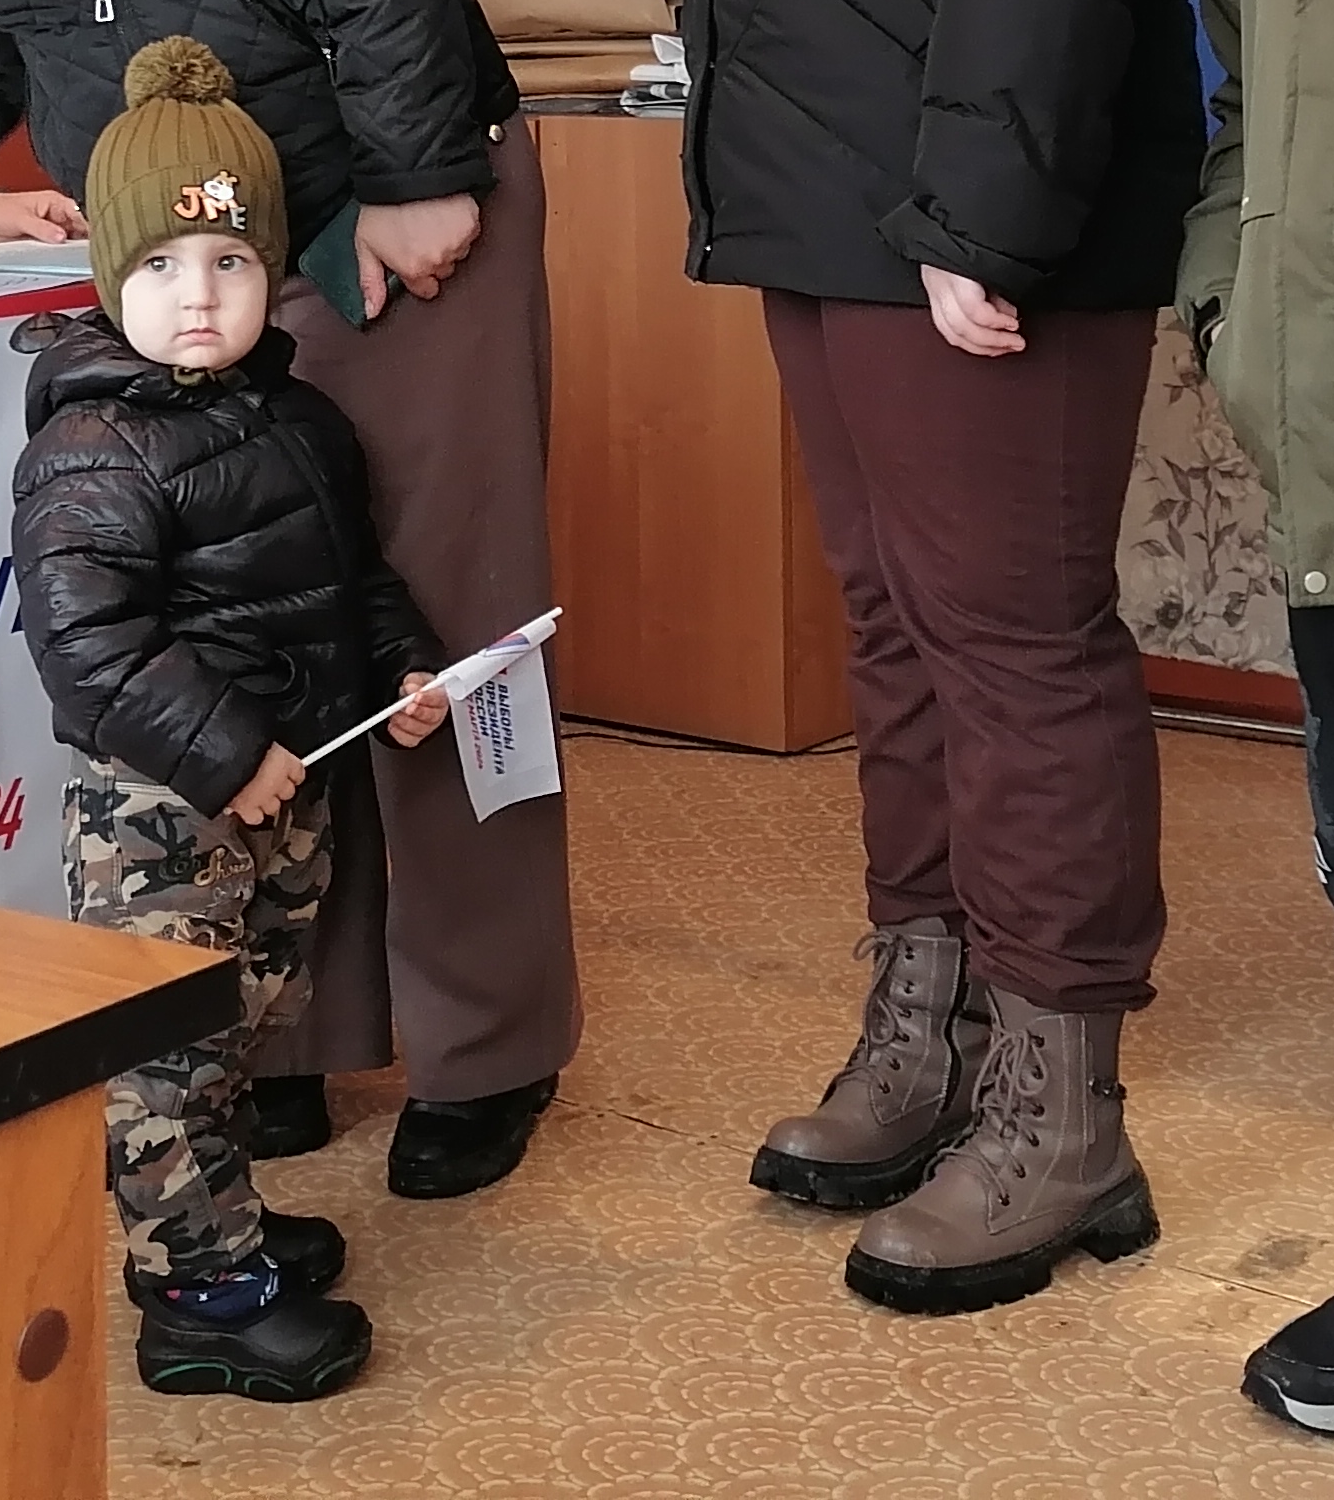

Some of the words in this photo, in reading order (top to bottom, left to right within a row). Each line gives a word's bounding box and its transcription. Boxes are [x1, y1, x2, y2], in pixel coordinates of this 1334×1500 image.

[474, 686, 490, 737] ОССИИ
[485, 680, 506, 775] ПРЕЗИДЕНТА
[498, 683, 516, 751] ВЫБОРЫ
